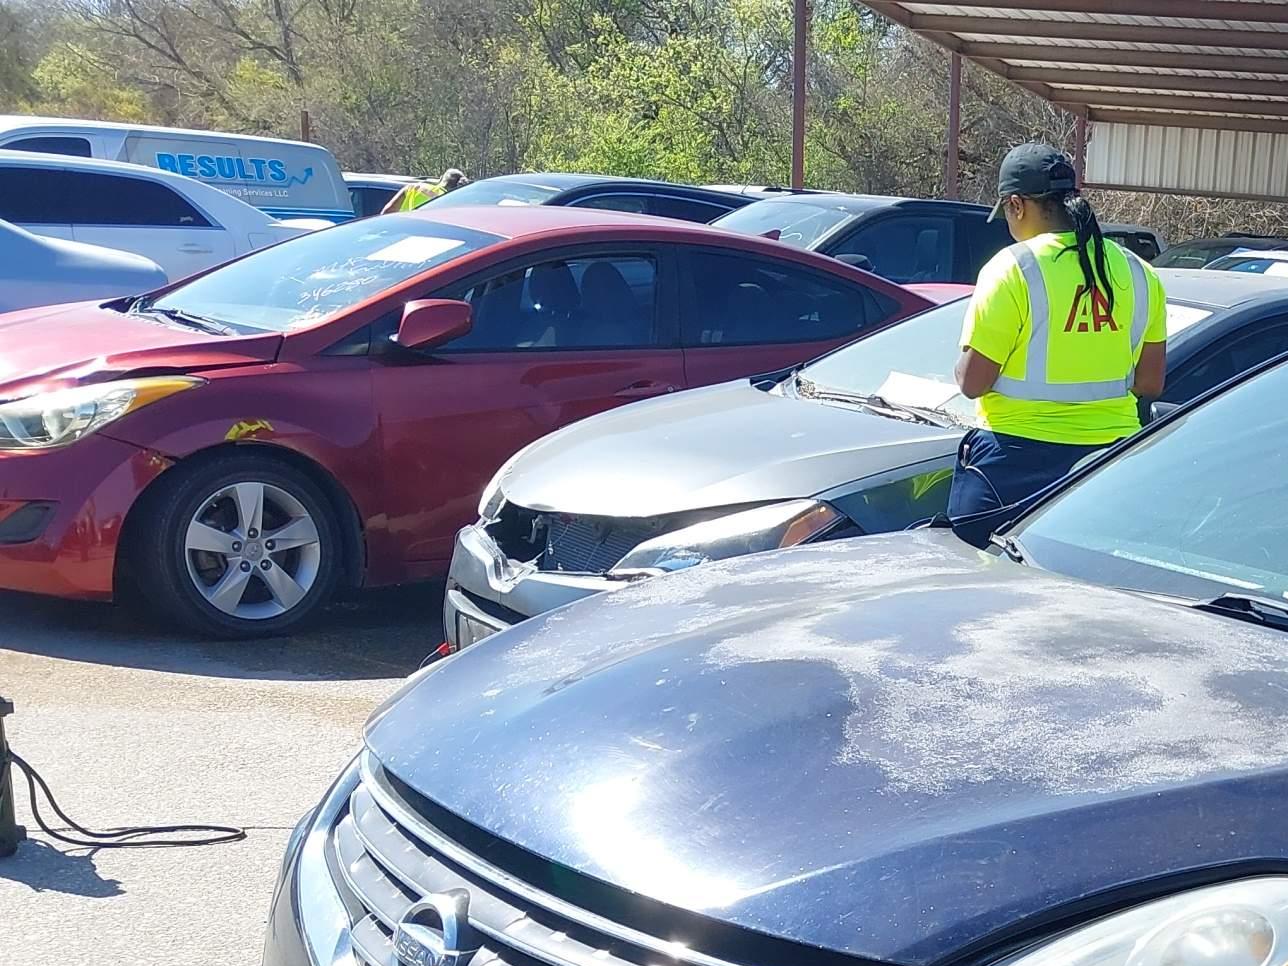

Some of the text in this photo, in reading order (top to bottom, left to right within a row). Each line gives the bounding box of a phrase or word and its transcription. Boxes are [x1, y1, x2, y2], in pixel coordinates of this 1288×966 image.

[155, 152, 288, 183] RESULTS
[243, 188, 272, 197] Services
[273, 190, 289, 198] LLC
